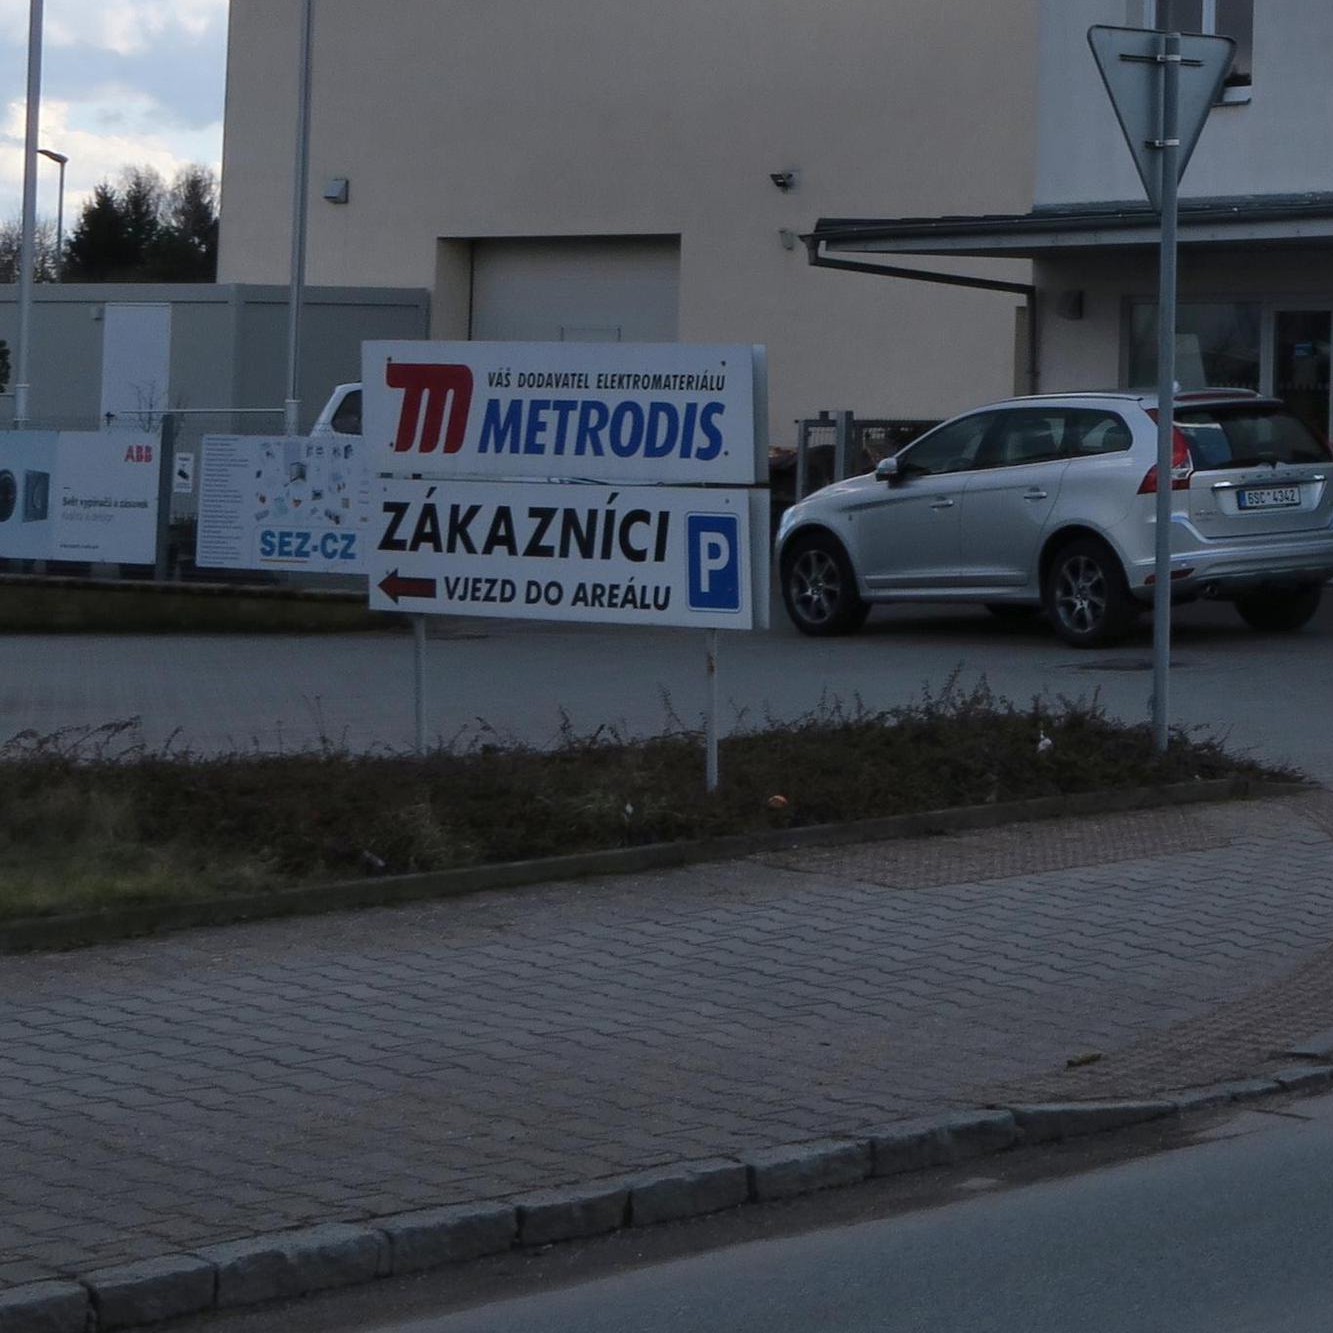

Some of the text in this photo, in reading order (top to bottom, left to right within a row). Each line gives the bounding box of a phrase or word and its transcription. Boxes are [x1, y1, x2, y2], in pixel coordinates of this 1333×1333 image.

[488, 368, 726, 393] VÁŠ DODAVATEL ELEKTROMATERIÁLU
[477, 398, 727, 461] METRODIS
[124, 444, 153, 463] ABB
[1247, 489, 1296, 505] 6SC 4342
[377, 486, 671, 563] ZÁKAZNÍCI
[259, 529, 357, 560] SEZ-CZ
[700, 531, 730, 593] P
[444, 576, 671, 611] VJEZD DO AREÁLU
